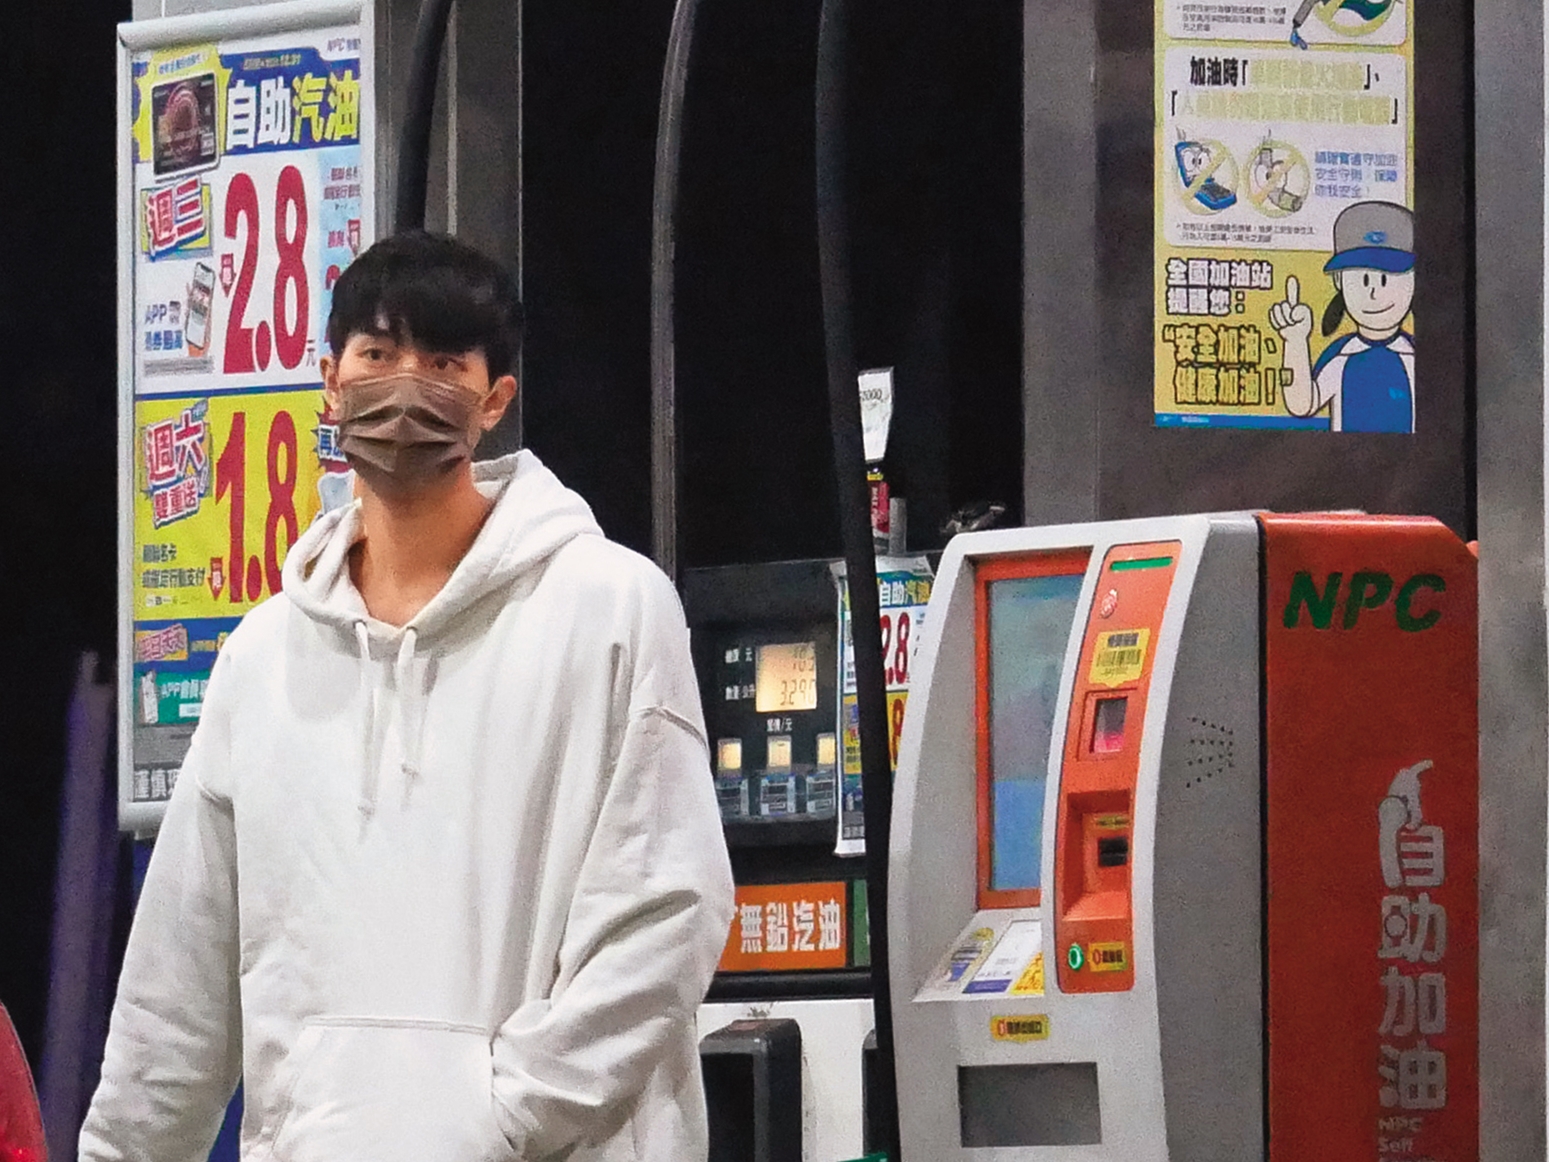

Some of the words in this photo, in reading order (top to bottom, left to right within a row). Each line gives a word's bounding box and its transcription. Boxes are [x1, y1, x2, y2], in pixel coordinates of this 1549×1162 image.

[226, 70, 360, 150] 自助汽油
[223, 165, 309, 374] 2.8
[1166, 257, 1272, 289] 全國加油站
[148, 410, 204, 481] 週六
[215, 410, 298, 603] 1.8
[1283, 571, 1446, 632] NPC
[740, 898, 841, 954] 無鉛汽油
[1378, 759, 1447, 1109] 自助加油
